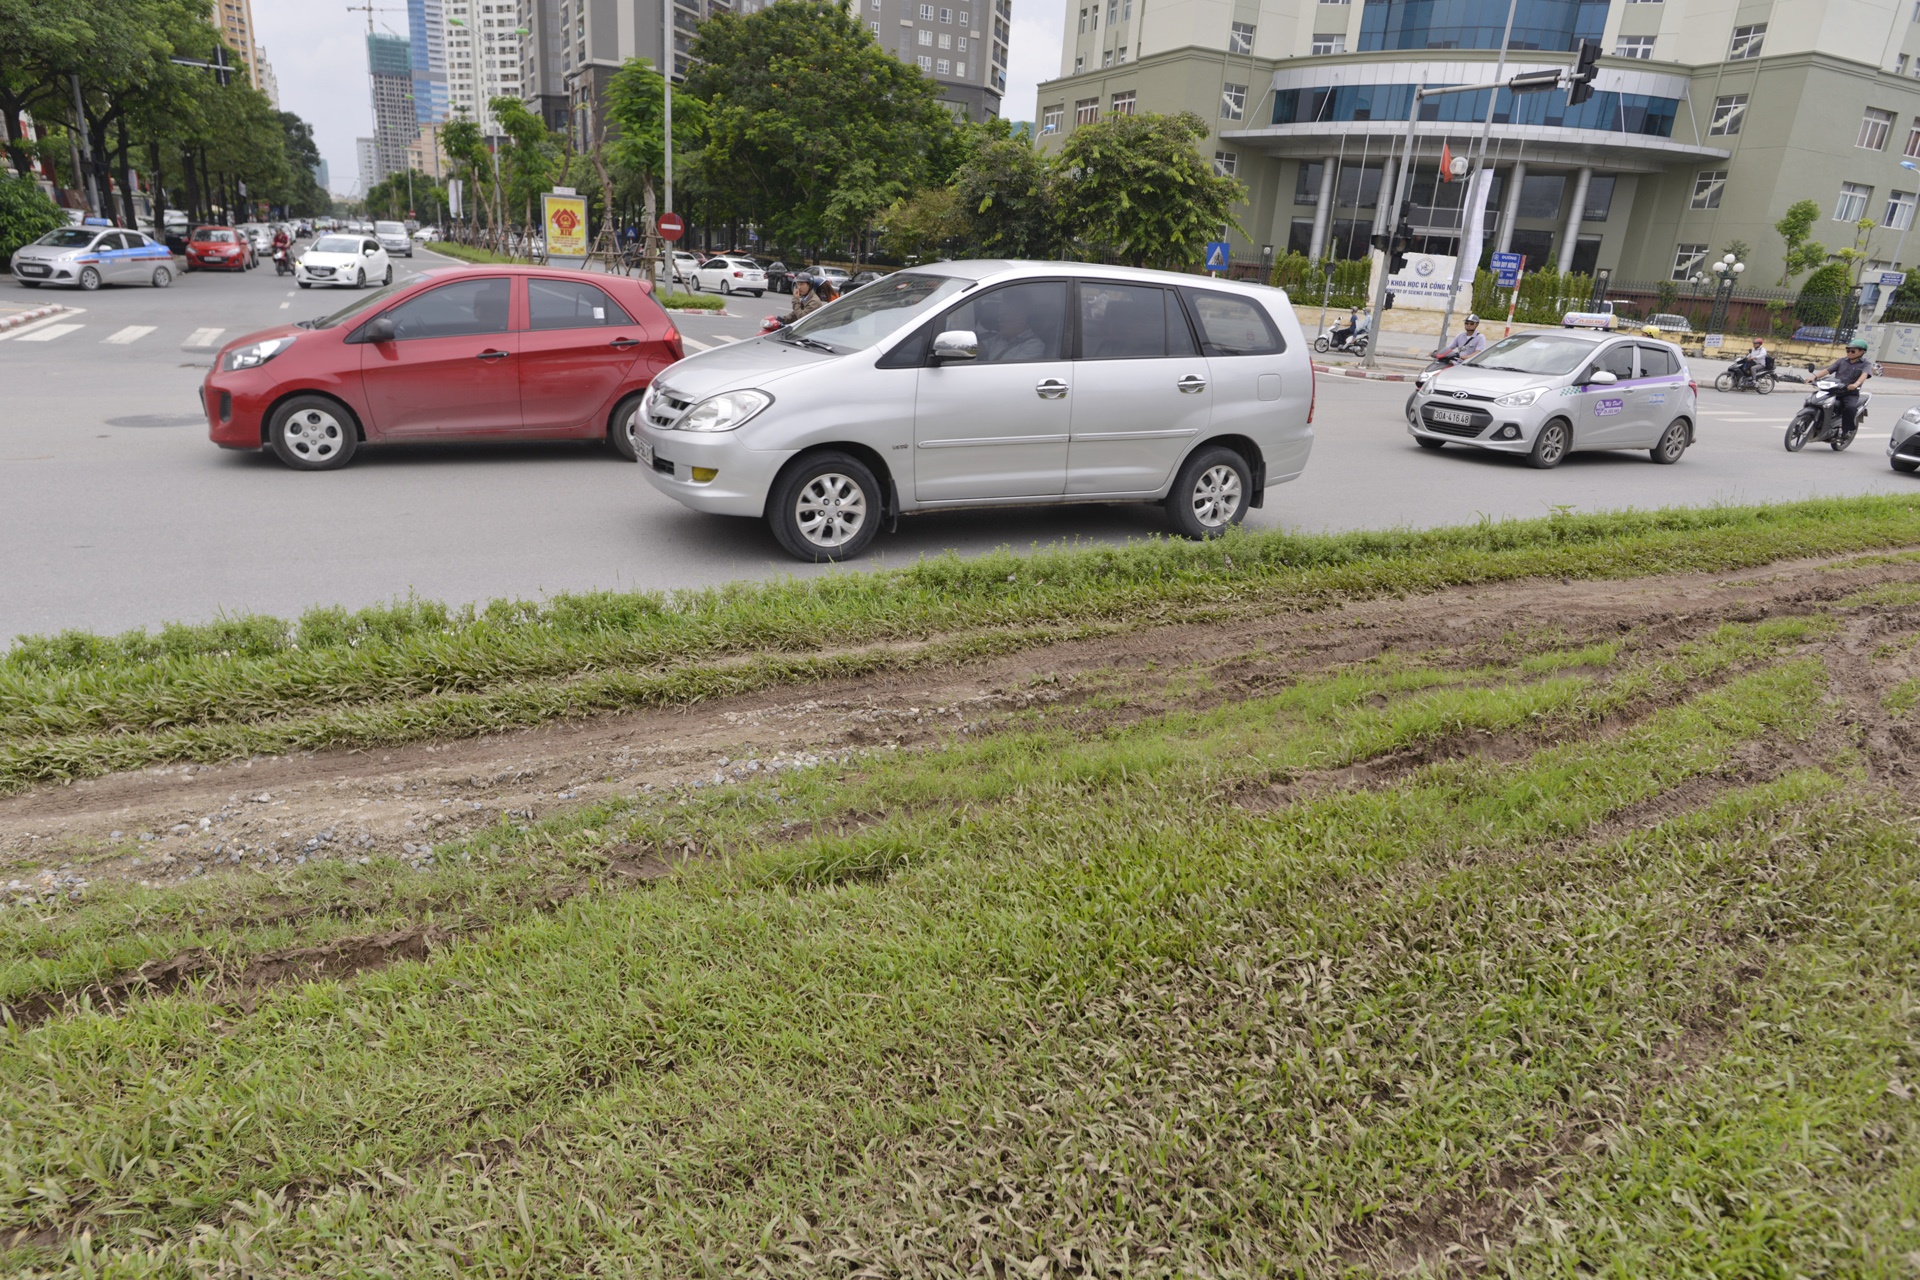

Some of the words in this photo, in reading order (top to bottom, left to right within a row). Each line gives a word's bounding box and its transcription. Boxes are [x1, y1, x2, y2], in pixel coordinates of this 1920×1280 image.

[1407, 281, 1420, 289] HỌC
[1421, 281, 1428, 289] VÀ
[1429, 282, 1446, 291] CÔNG
